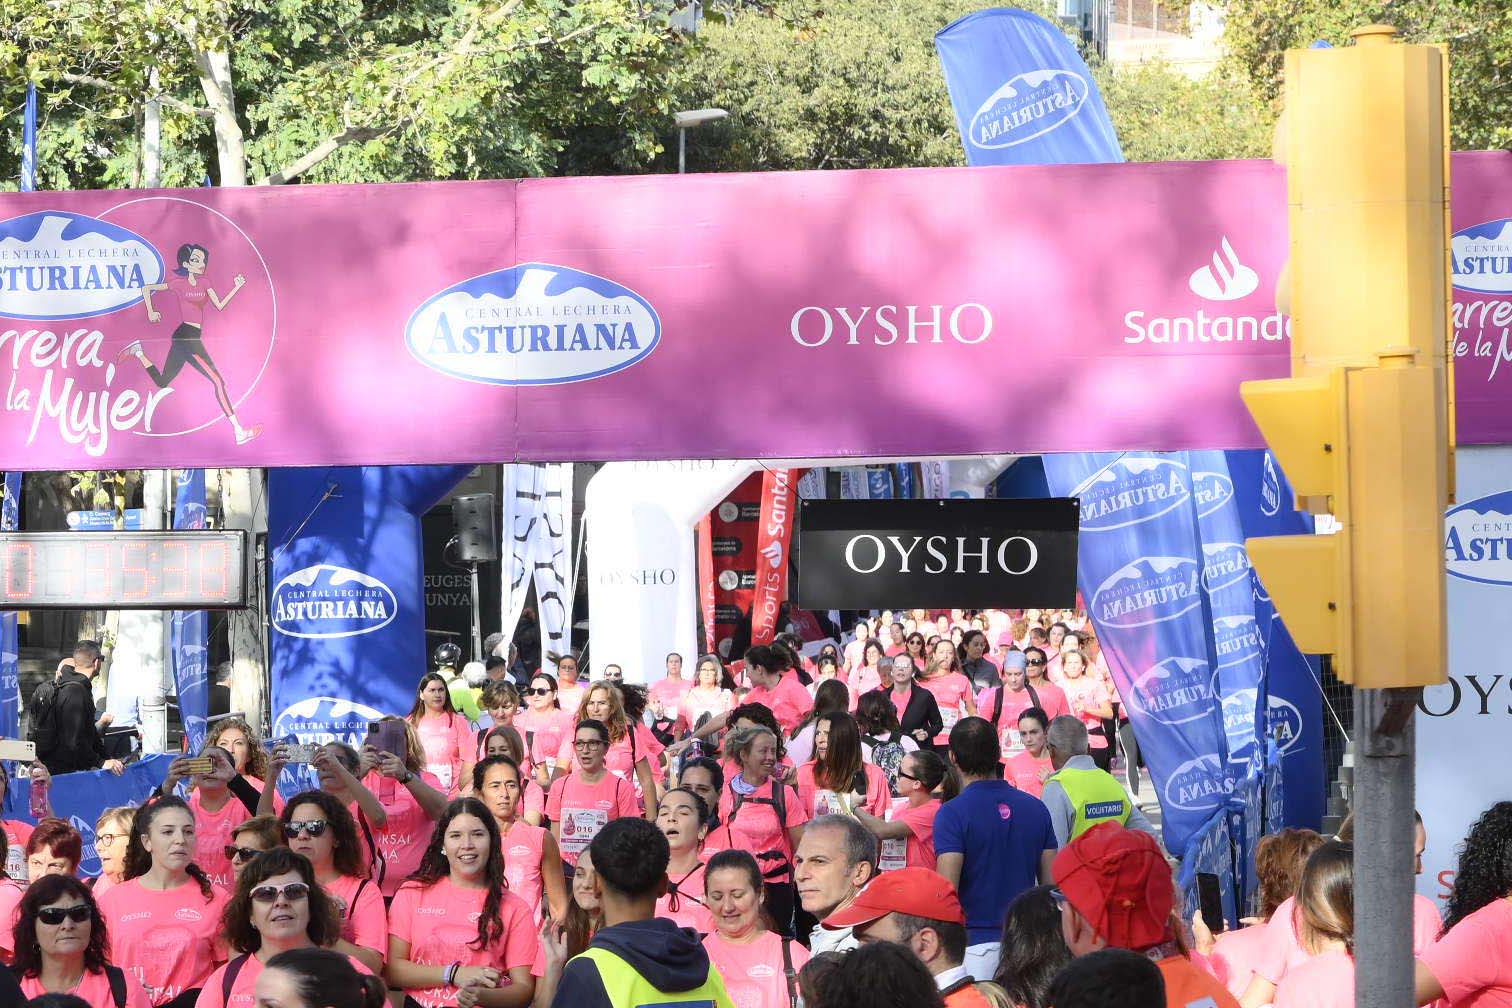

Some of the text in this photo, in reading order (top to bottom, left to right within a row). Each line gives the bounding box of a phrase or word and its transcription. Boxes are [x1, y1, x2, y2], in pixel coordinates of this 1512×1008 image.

[67, 247, 140, 260] LECHERA
[465, 303, 633, 319] CENTRAL LECHERA
[790, 302, 993, 347] OYSHO
[427, 311, 641, 354] ASTURIANA
[5, 372, 31, 412] la
[26, 364, 174, 457] Mujer
[844, 533, 1040, 575] OYSHO
[288, 589, 383, 599] CENTRAL LECHERA
[275, 596, 388, 623] ASTURIANA
[289, 721, 330, 730] CENTRAL
